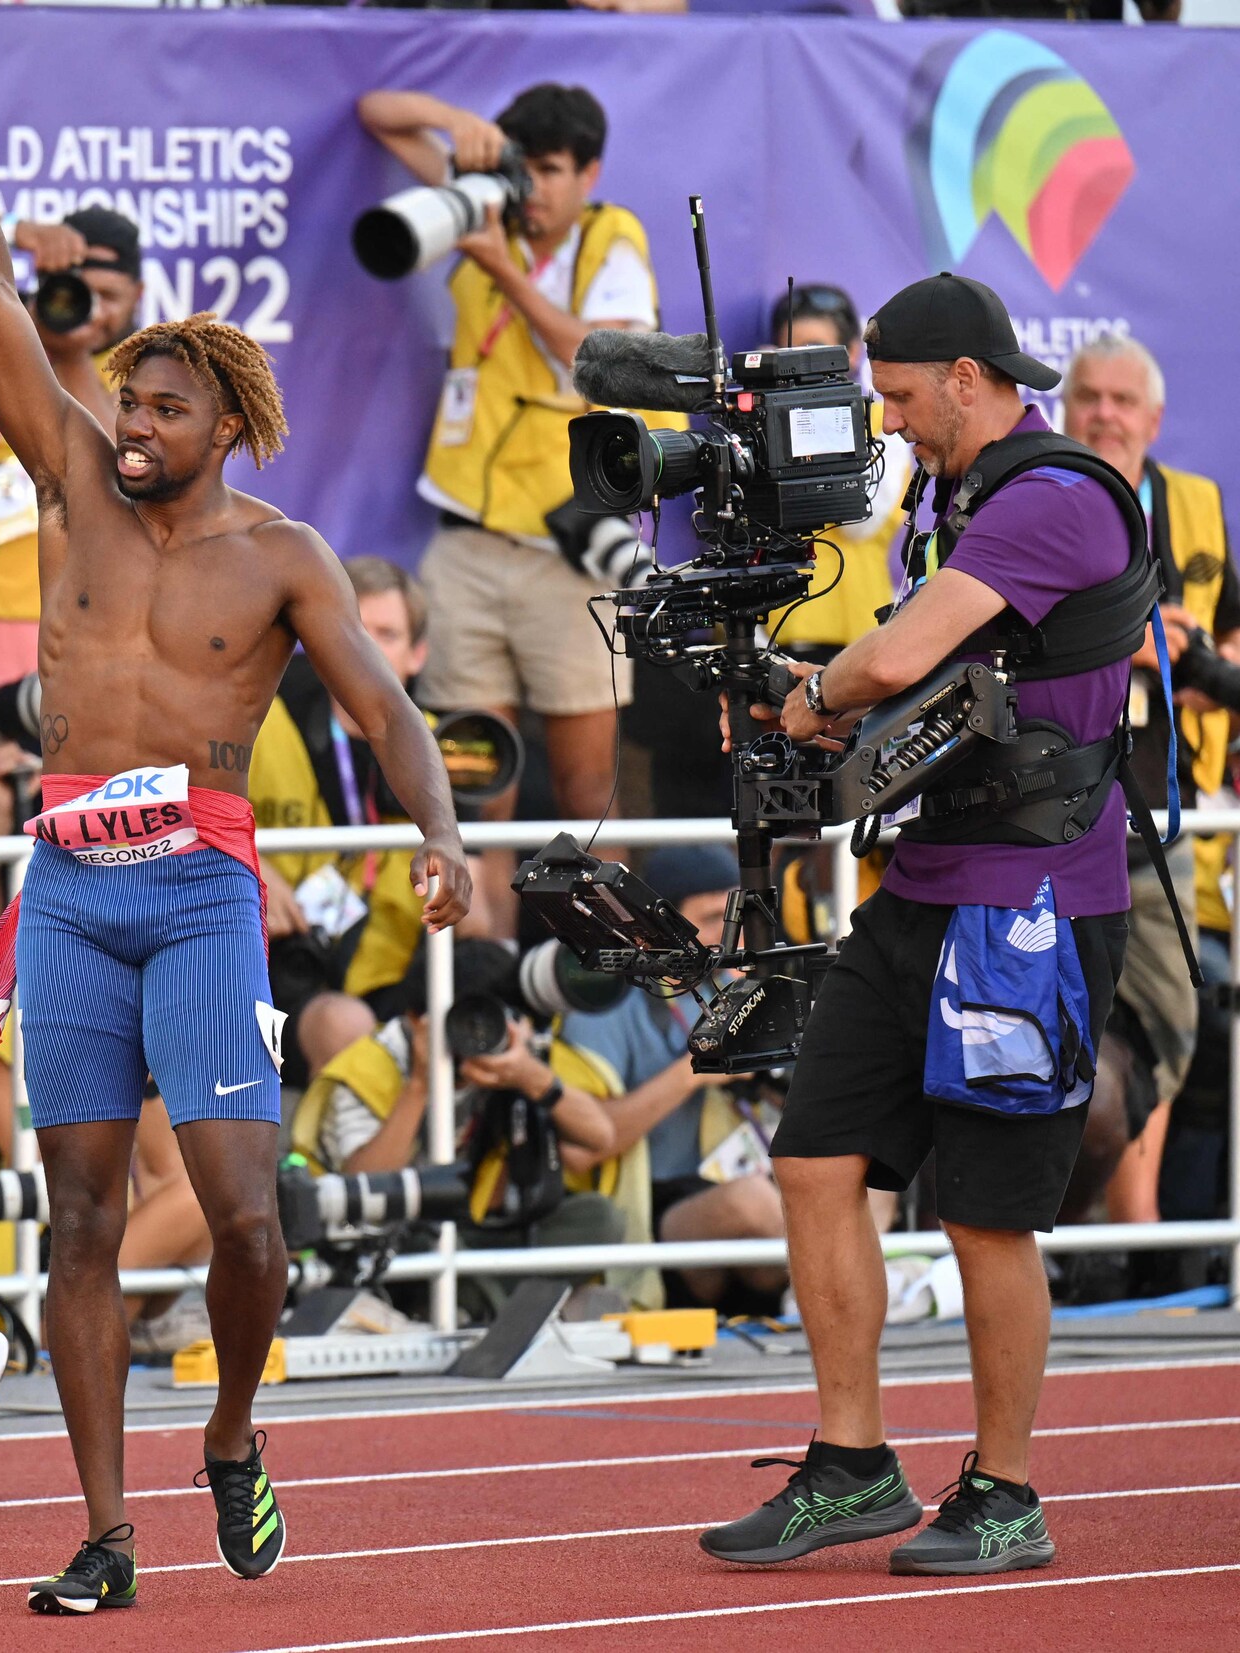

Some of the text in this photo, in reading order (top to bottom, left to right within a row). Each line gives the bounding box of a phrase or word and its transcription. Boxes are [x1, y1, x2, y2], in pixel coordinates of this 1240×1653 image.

[50, 126, 293, 183] ATHLETICS
[207, 739, 254, 772] ICO
[35, 804, 183, 846] N. LYLES
[74, 839, 174, 865] REGON22
[727, 987, 767, 1037] STEADICAM
